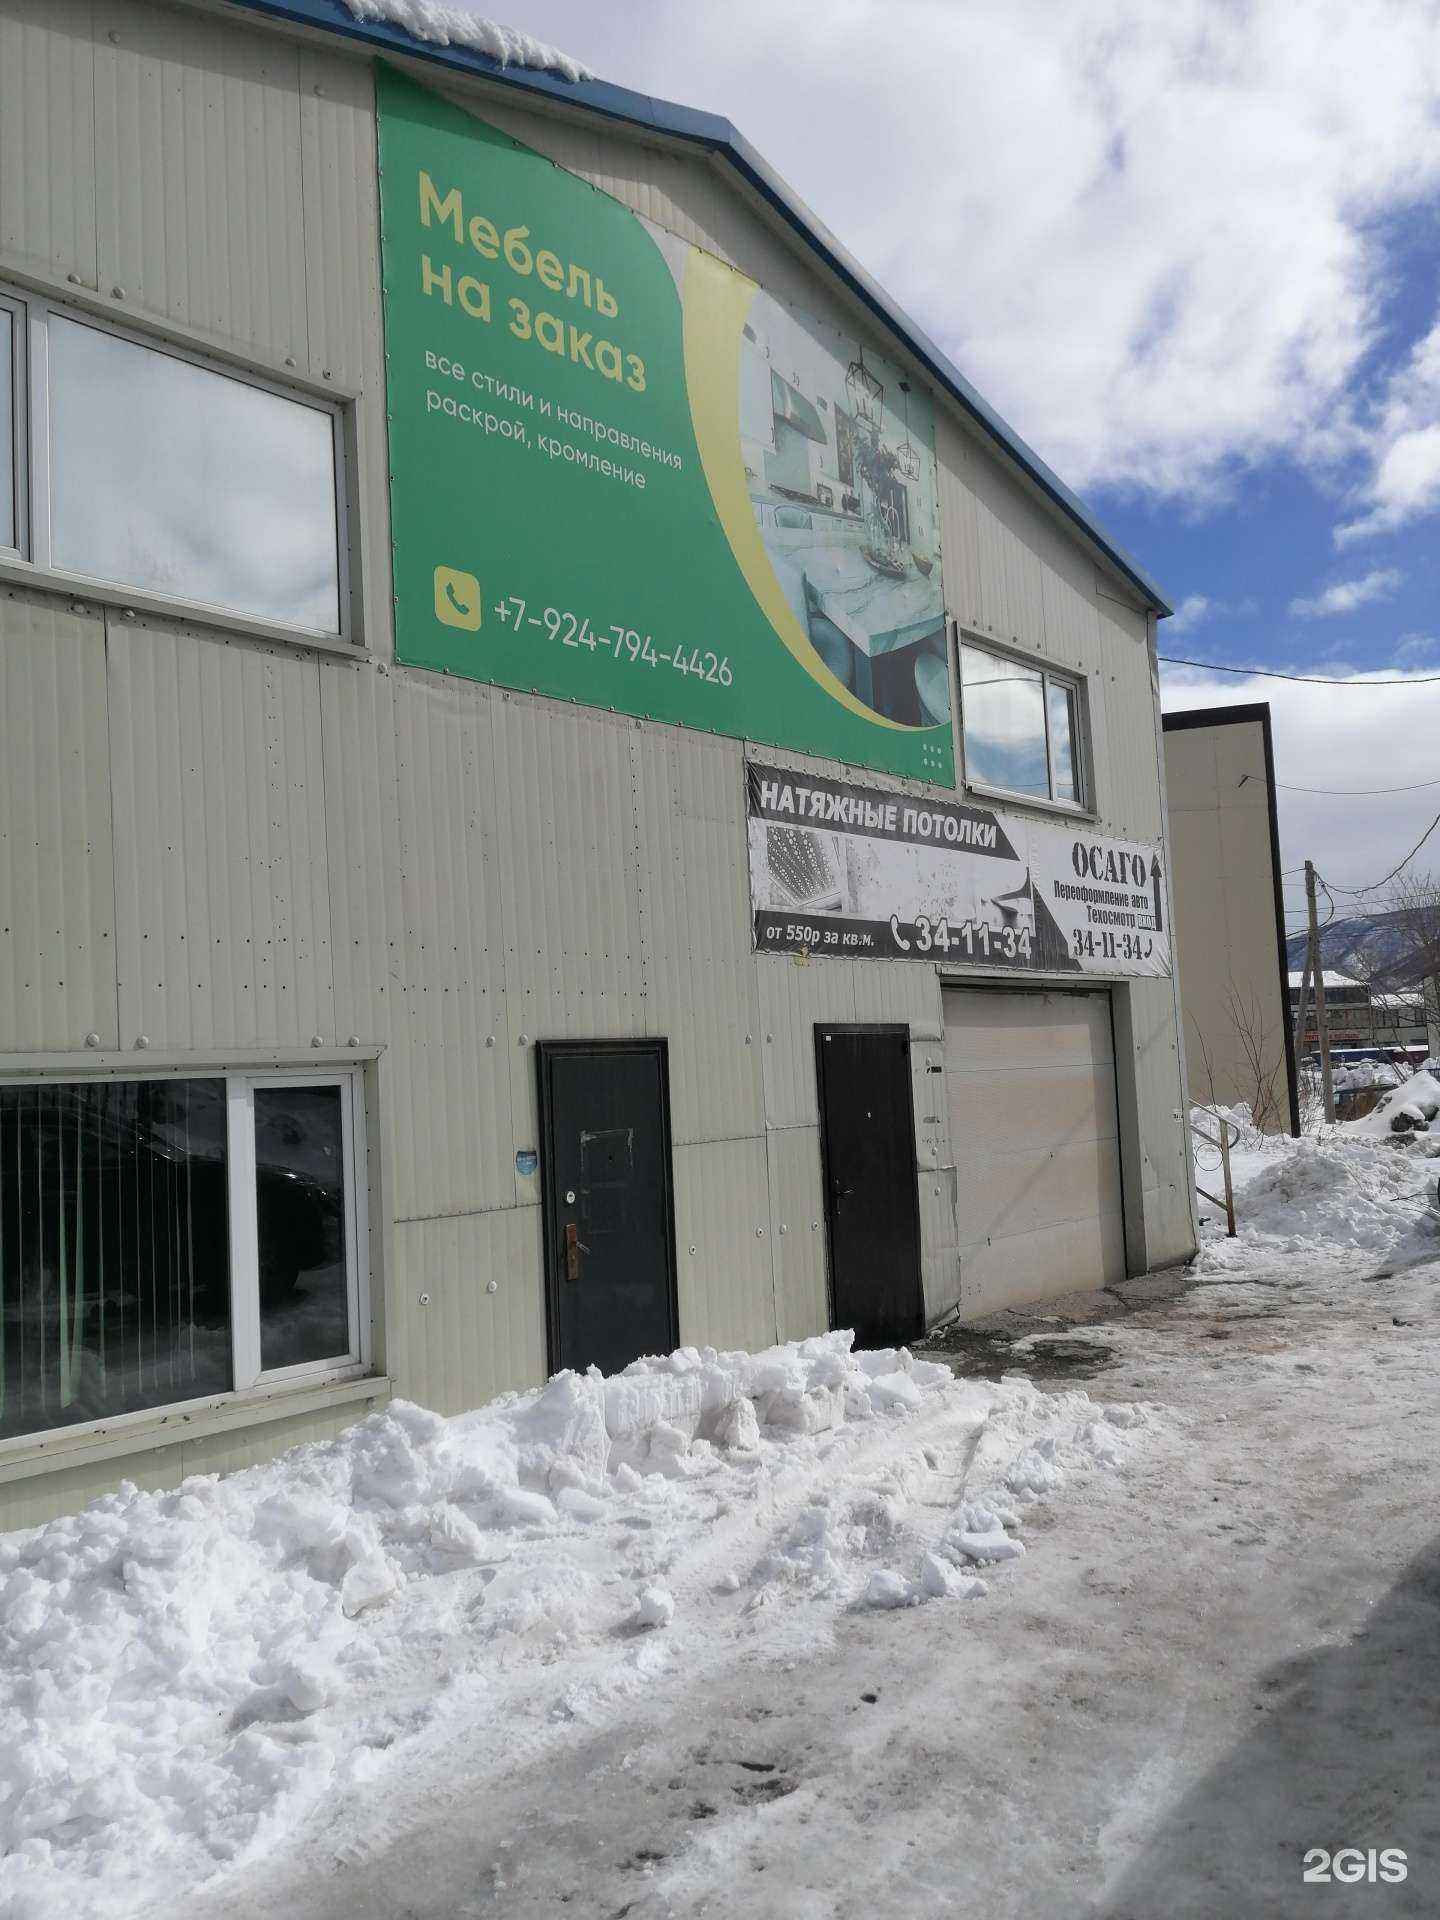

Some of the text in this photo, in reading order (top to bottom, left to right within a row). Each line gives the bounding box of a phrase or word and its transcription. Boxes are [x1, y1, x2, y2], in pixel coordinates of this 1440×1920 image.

[419, 170, 618, 318] Мебель
[422, 254, 647, 393] на заказ
[425, 350, 682, 470] все стили и направления
[427, 389, 646, 488] раскрой, кромление
[494, 596, 733, 687] +7-924-794-4426
[761, 780, 997, 849] НАТЯЖНЫЕ ПОТОЛКИ
[1072, 842, 1147, 887] ОСАГО
[1054, 880, 1149, 909] Переоформление авто
[1086, 905, 1136, 928] Техосмотр
[766, 924, 875, 947] от 550р за кв.м.
[914, 915, 1032, 960] 34-11-34
[1073, 928, 1143, 960] 34-11-34
